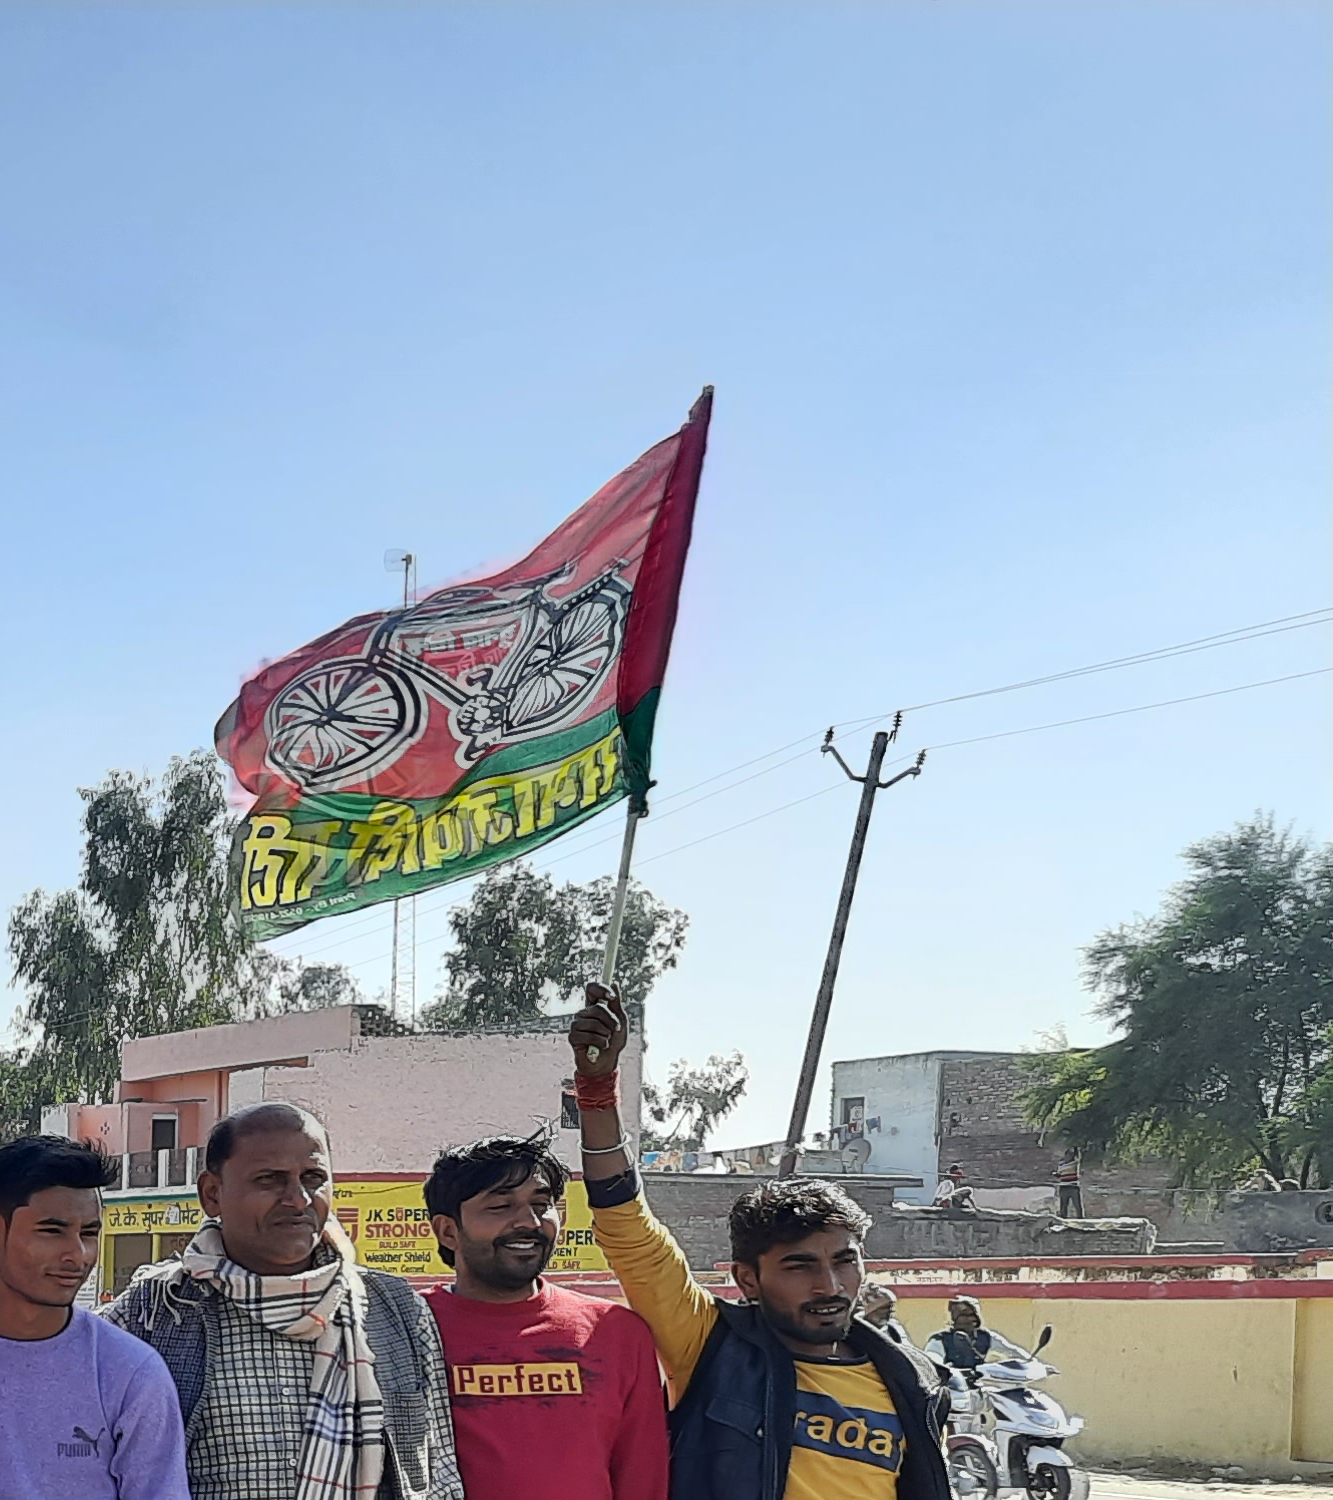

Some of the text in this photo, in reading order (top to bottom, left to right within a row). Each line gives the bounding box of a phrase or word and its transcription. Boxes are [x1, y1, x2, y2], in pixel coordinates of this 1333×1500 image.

[365, 1209, 383, 1222] JK
[365, 1223, 431, 1238] STRONG
[457, 1365, 578, 1394] Perfect
[57, 1442, 91, 1458] PUMA
